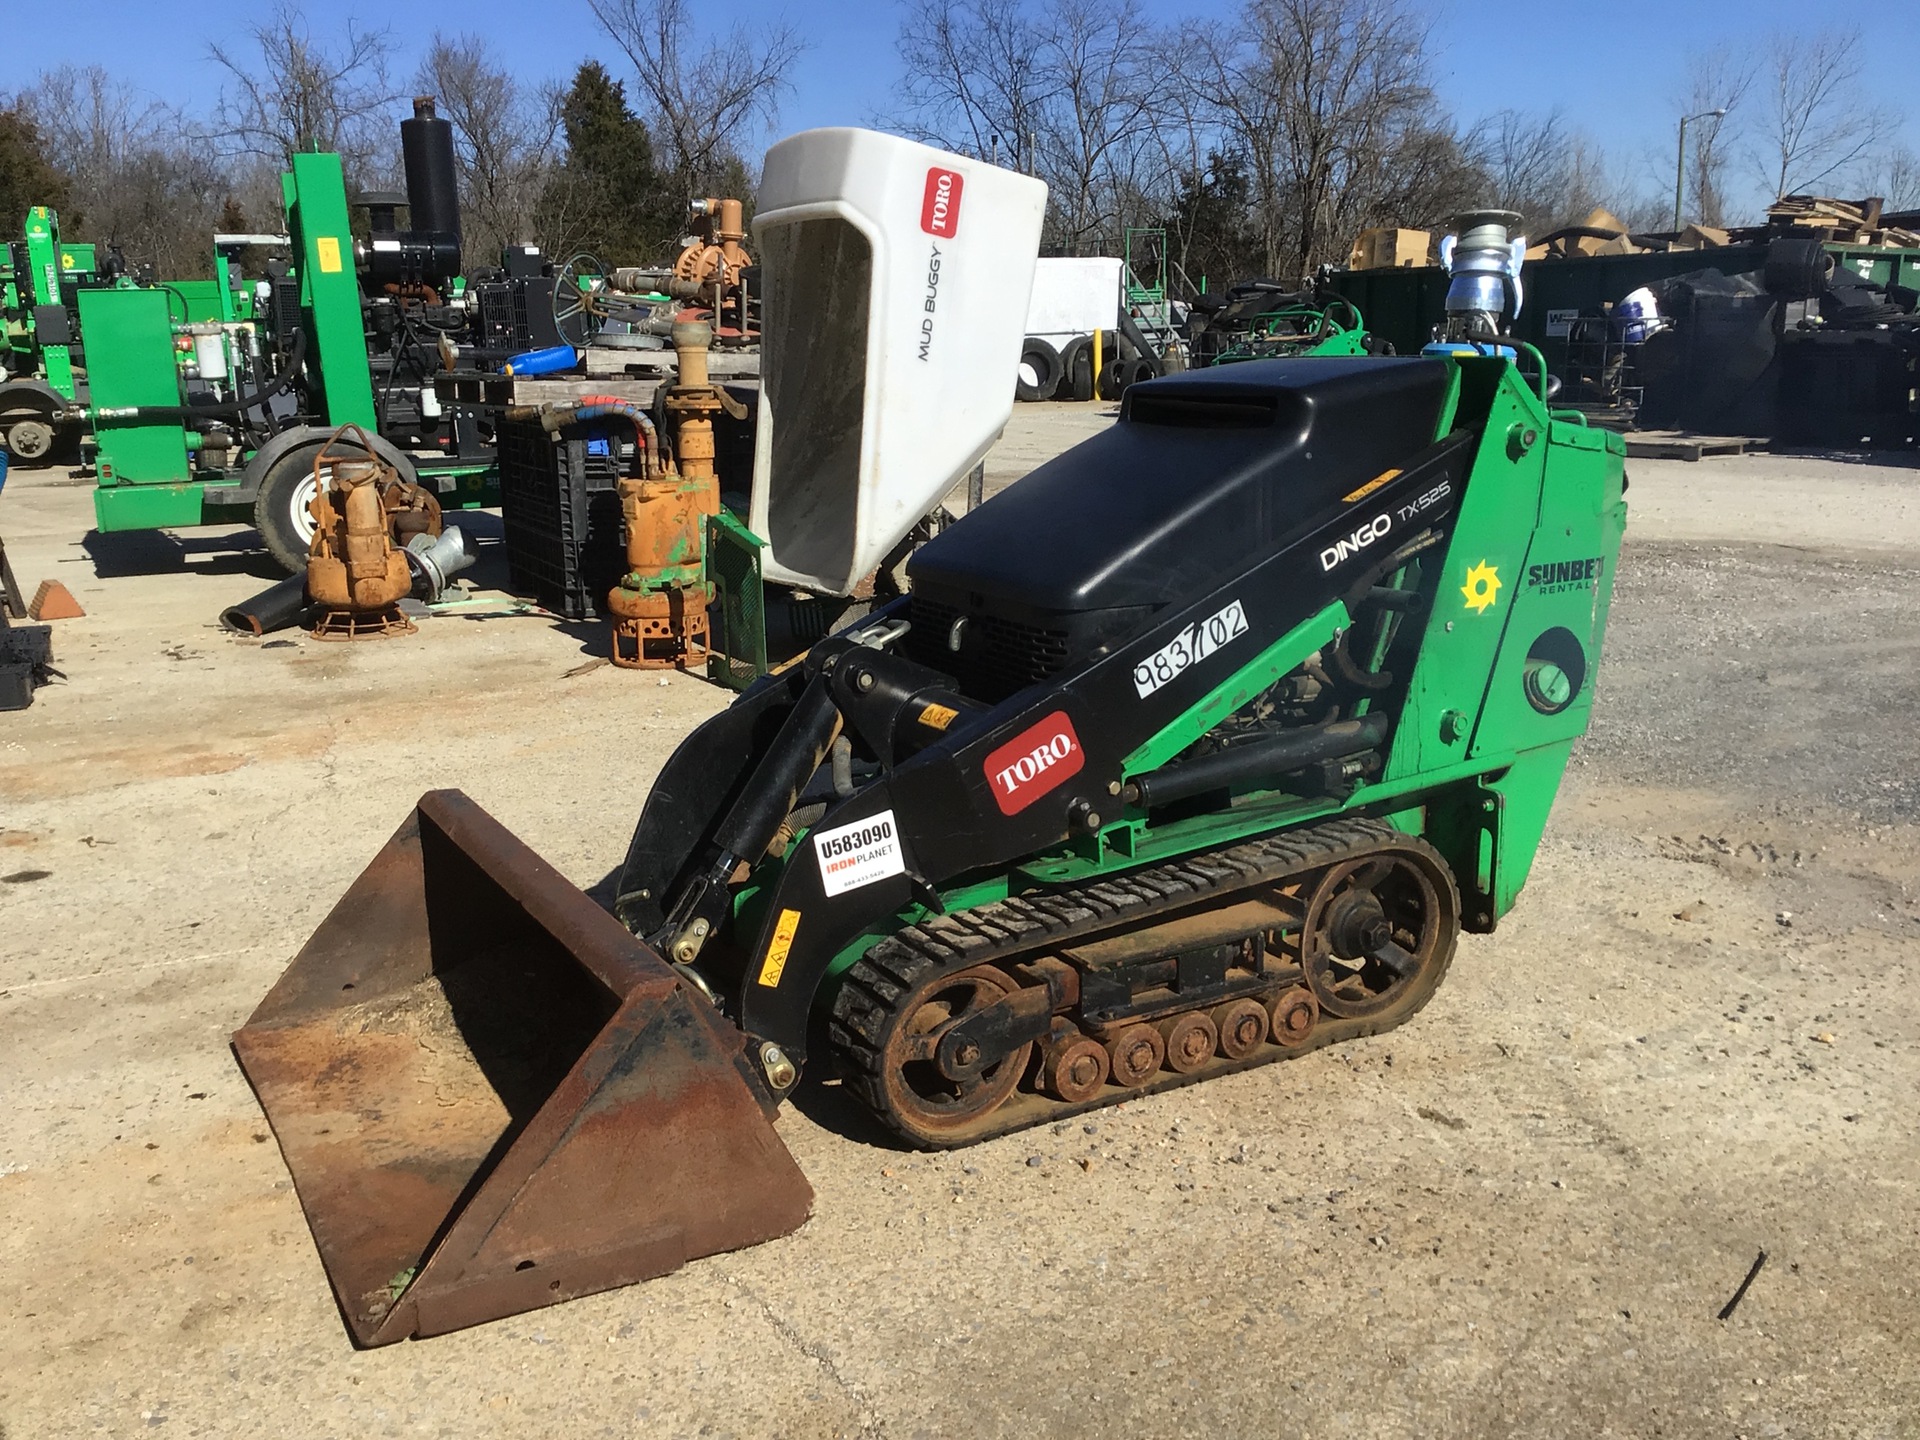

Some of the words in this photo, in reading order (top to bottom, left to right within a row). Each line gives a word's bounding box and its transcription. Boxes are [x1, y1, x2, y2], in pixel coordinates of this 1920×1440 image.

[932, 174, 952, 230] TORO
[925, 245, 942, 313] BUGGY
[918, 318, 933, 362] MUD
[1320, 513, 1392, 572] DINGO
[995, 733, 1071, 795] TORO
[821, 821, 892, 859] U583090
